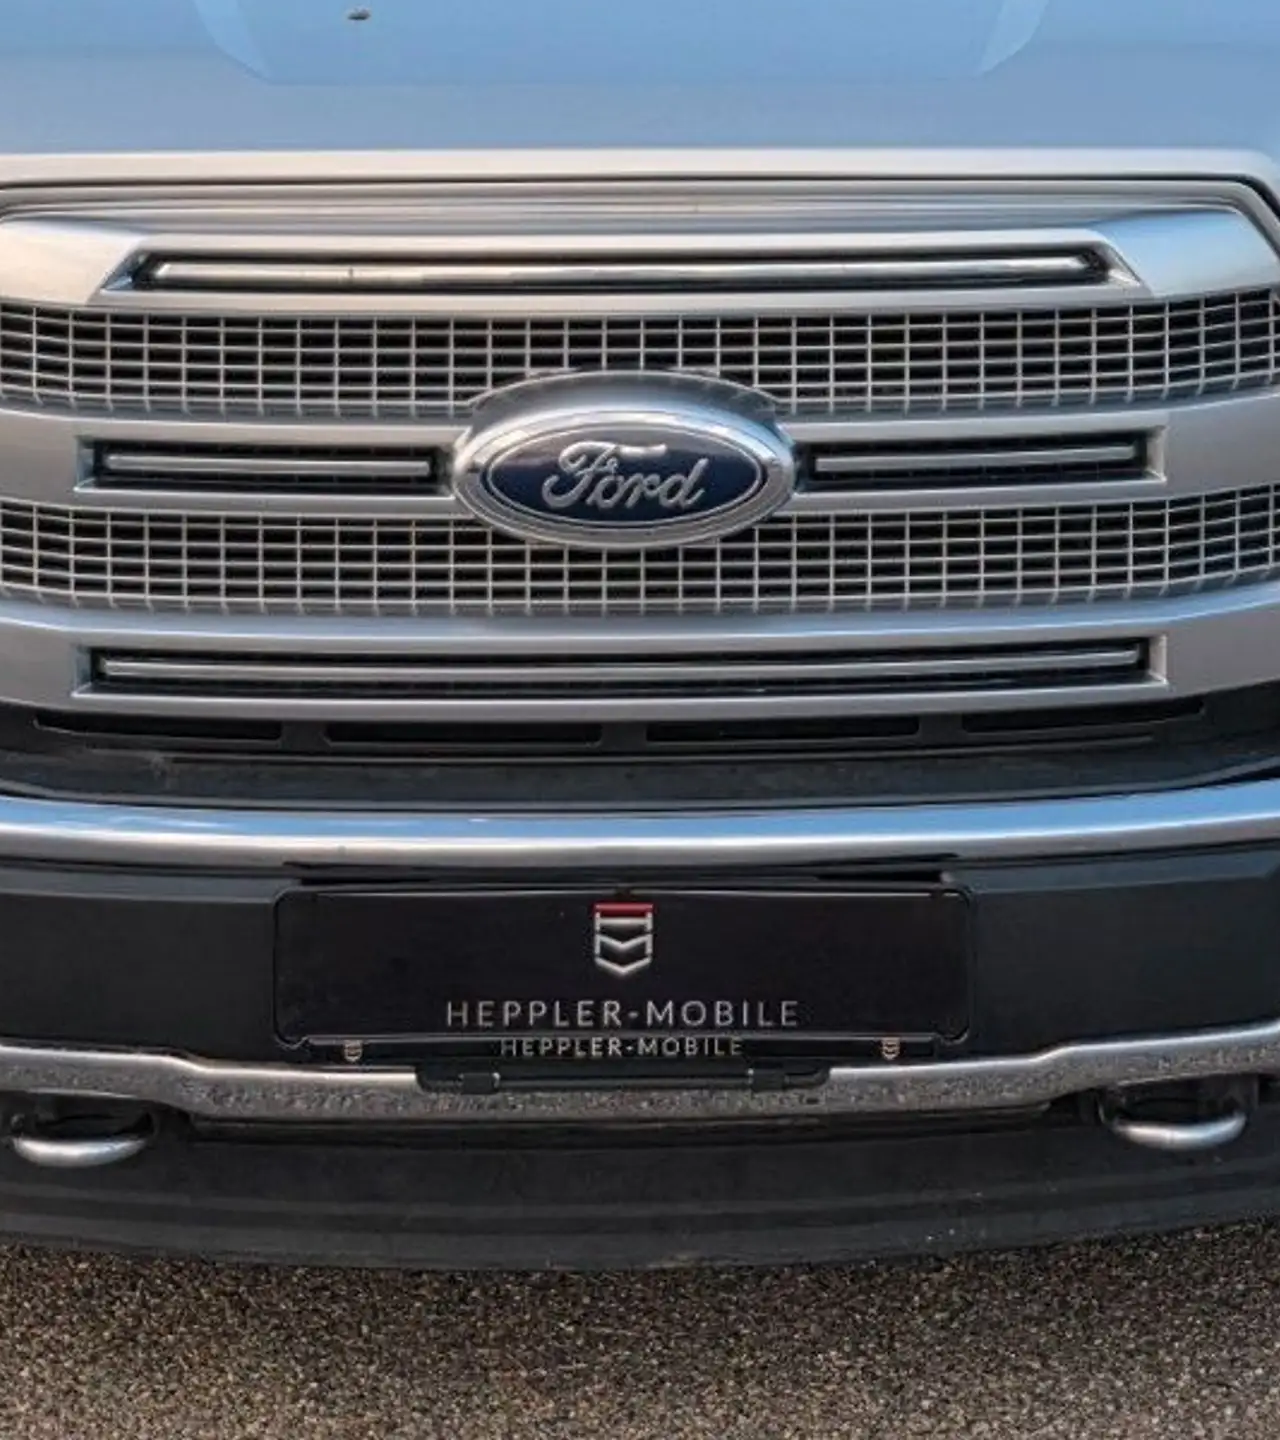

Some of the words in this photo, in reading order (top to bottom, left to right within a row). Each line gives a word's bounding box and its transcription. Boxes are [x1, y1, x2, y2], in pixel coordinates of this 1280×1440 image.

[541, 439, 710, 510] Ford
[445, 999, 800, 1028] HEPPLER-MOBILE
[499, 1036, 744, 1057] HEPPLER-MOBILE
